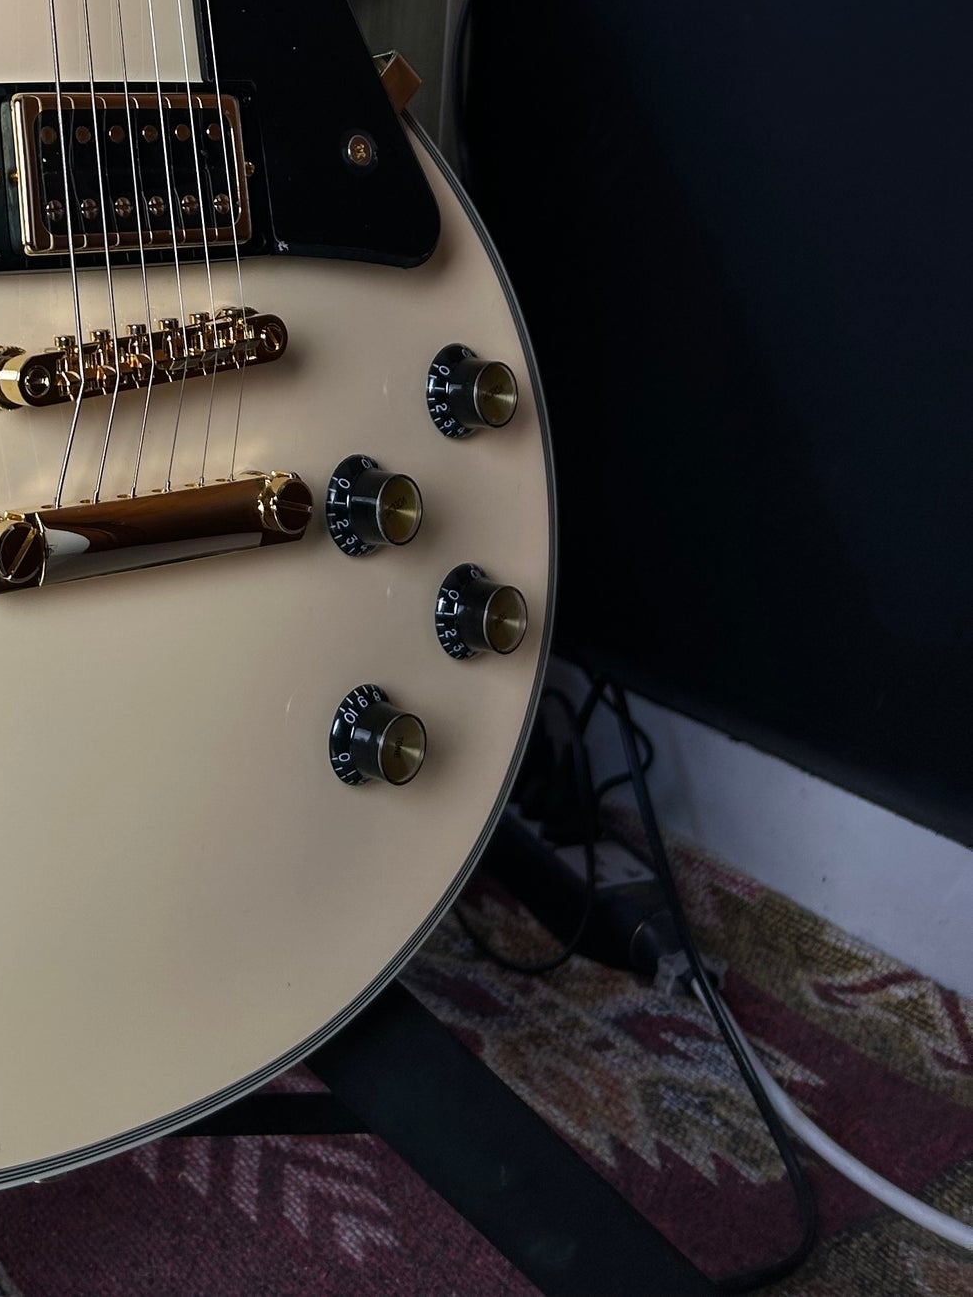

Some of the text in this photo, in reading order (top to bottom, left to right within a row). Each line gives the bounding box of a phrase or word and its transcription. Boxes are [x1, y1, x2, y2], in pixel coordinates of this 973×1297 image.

[336, 518, 350, 530] 2
[346, 534, 359, 546] 3
[444, 628, 457, 639] 2
[343, 707, 359, 724] 10
